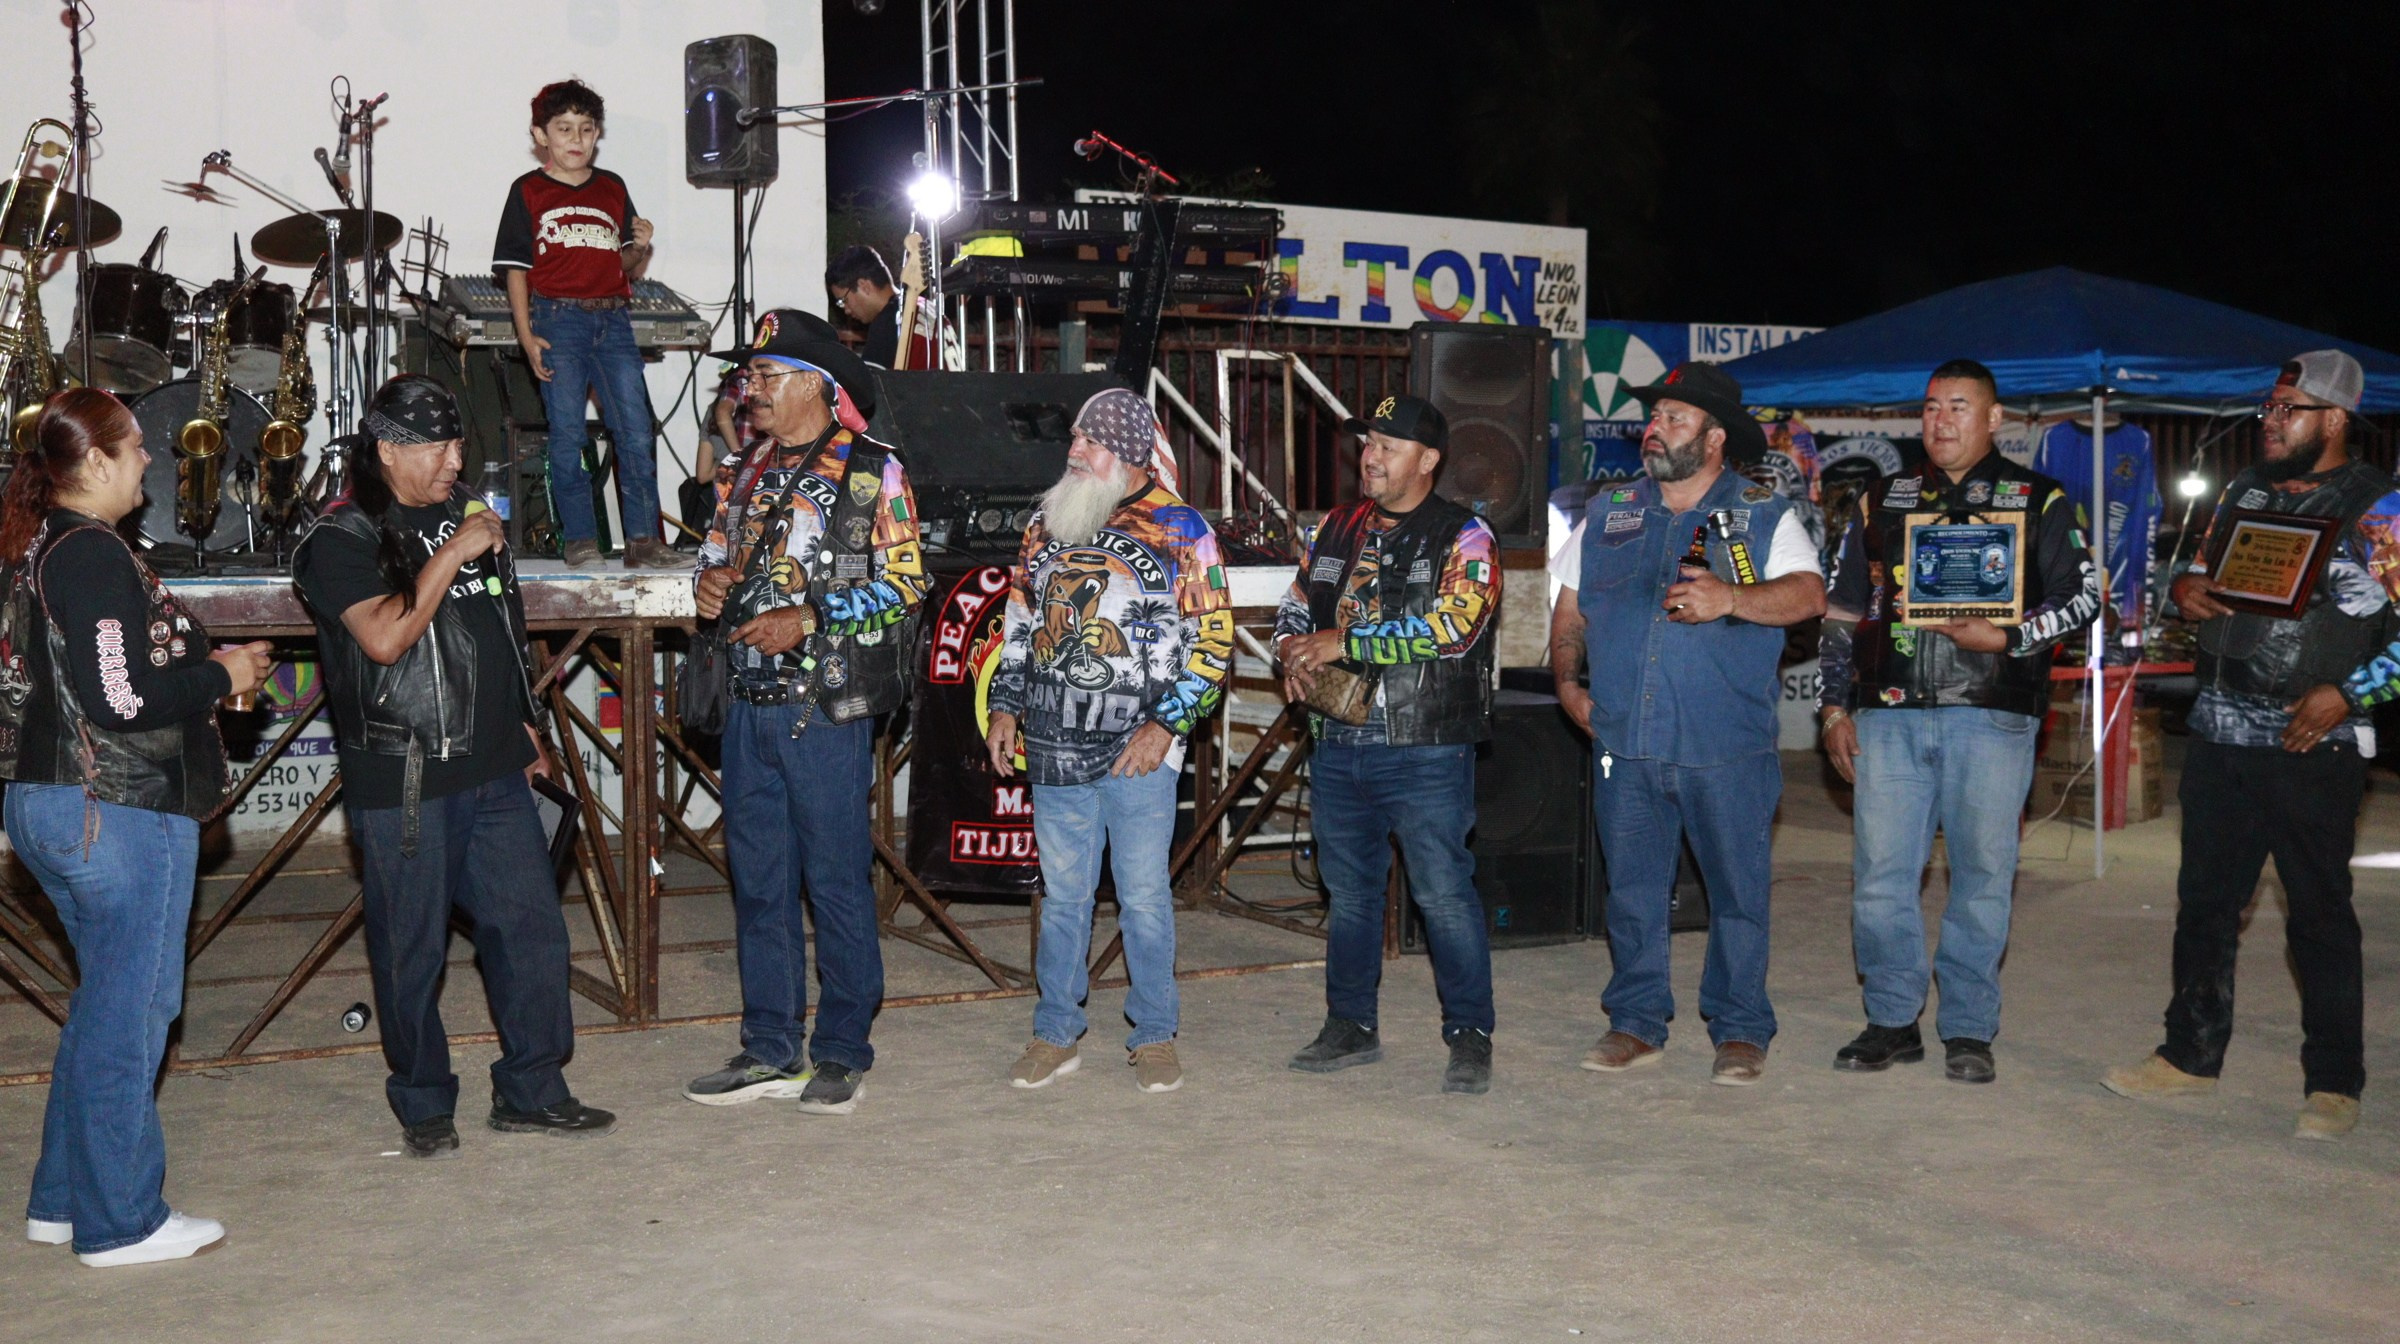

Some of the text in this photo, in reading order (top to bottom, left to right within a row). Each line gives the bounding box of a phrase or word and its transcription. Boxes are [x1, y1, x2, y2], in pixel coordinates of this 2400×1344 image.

[1256, 238, 1542, 327] LTON
[1697, 325, 1815, 355] INSTALA
[779, 473, 837, 517] VEJO
[935, 565, 1015, 679] PEAC
[957, 828, 1039, 857] TIJU
